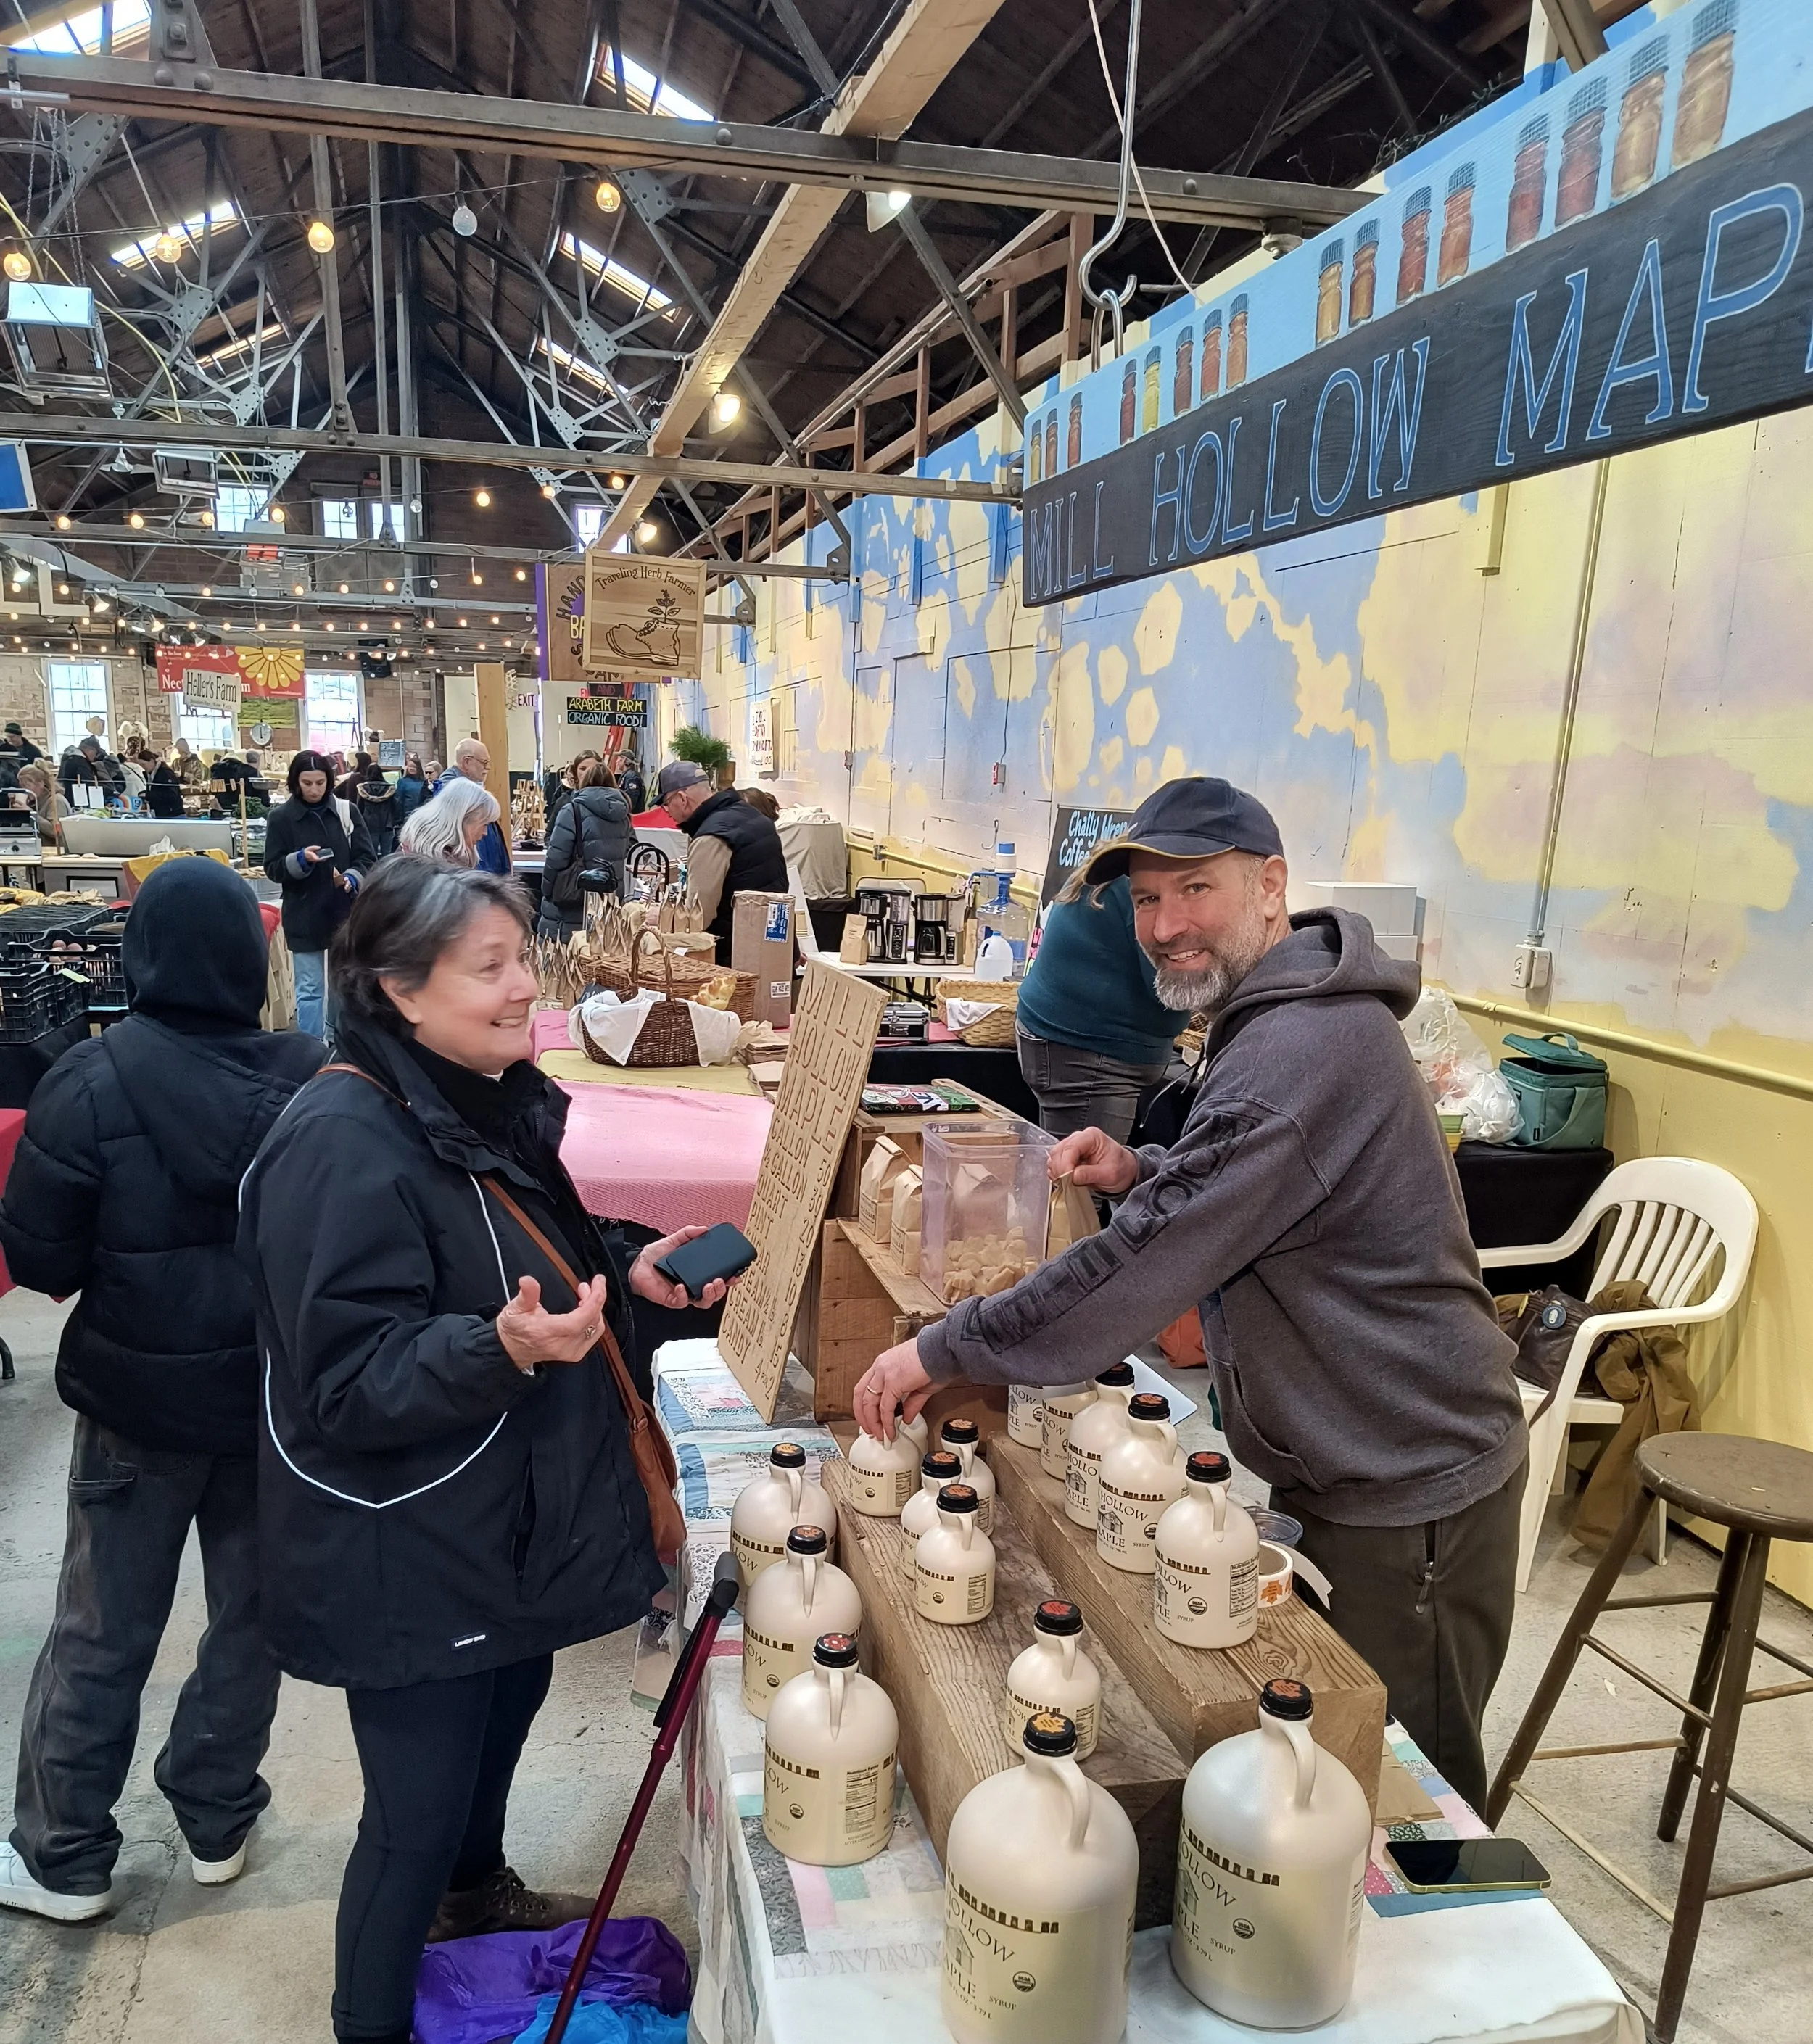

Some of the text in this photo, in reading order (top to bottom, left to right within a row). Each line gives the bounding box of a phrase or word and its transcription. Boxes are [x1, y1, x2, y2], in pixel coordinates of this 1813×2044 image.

[1029, 183, 1813, 600] MILL HOLLOW MAP
[595, 566, 696, 597] Traveling Herb Farmer
[186, 671, 236, 703] Heller's Farm
[518, 694, 534, 706] EXIT
[569, 698, 643, 713] ARABETH FARM
[568, 712, 611, 725] ORGANIC
[1059, 837, 1091, 867] Coffee
[801, 967, 868, 1048] MILL
[789, 1015, 862, 1101] HOLLOW
[776, 1062, 847, 1154] MAPLE
[771, 1117, 811, 1168] GALLON
[771, 1151, 808, 1203] GALLON
[750, 1201, 773, 1239] PINT
[757, 1174, 814, 1248] QUART 20
[729, 1286, 759, 1337] CREAM
[742, 1268, 764, 1309] REAM
[780, 1313, 789, 1337] 8
[785, 1277, 797, 1307] 10
[722, 1312, 751, 1364] CANDY
[765, 1376, 775, 1400] 2
[1101, 1490, 1149, 1522] HOLLOW
[1181, 1837, 1236, 1906] OLLOW
[1210, 1937, 1236, 1955] SYRUP
[988, 1995, 1017, 2010] SYRUP
